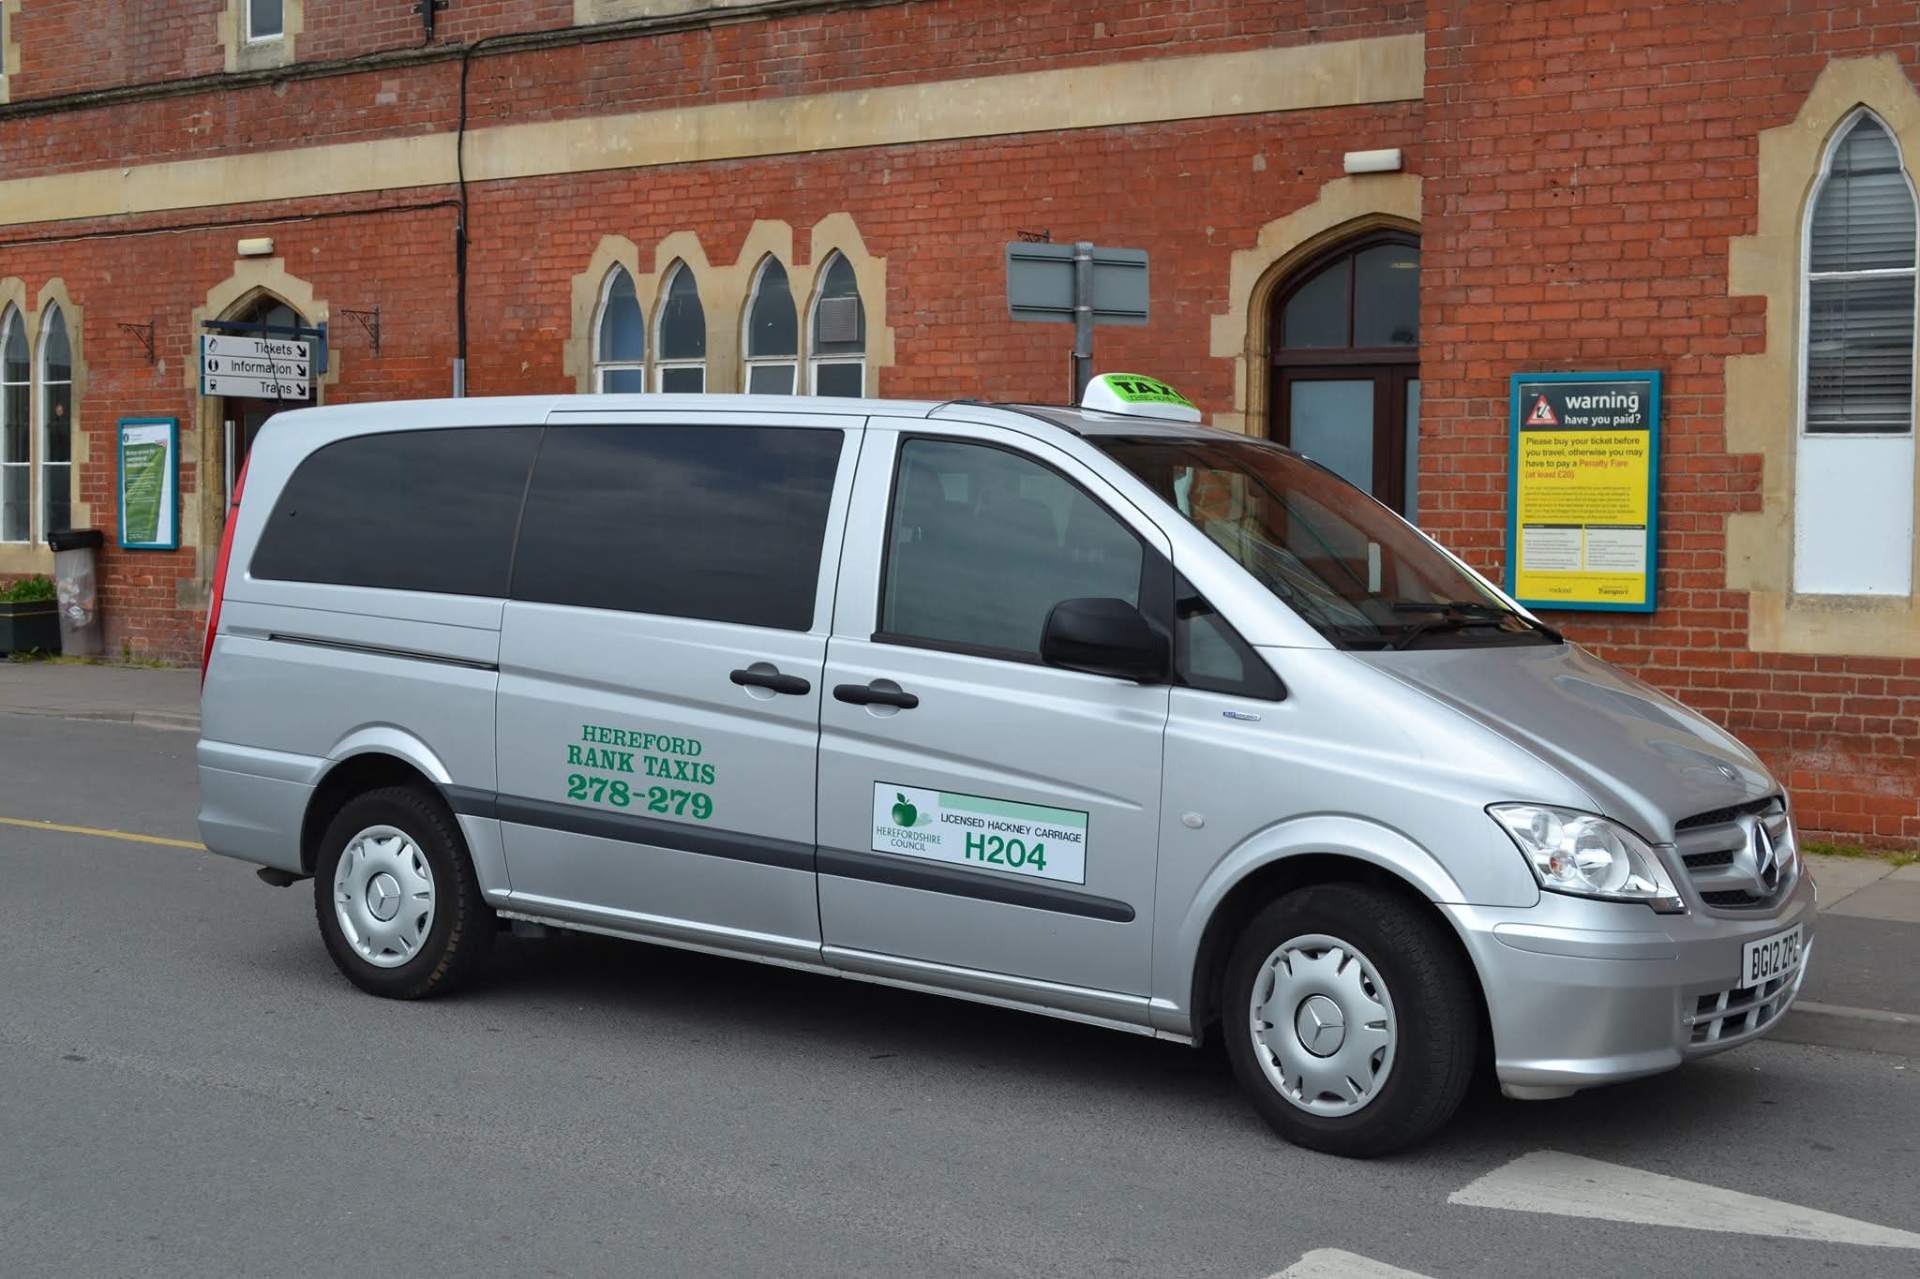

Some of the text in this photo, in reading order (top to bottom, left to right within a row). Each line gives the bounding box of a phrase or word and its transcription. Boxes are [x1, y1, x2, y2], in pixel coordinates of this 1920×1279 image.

[254, 342, 293, 355] Tickets
[231, 360, 292, 375] Information
[1113, 381, 1186, 401] TAXI
[1565, 391, 1639, 413] warning
[1564, 415, 1589, 424] have
[1591, 417, 1611, 426] you
[1613, 413, 1641, 427] paid?
[1526, 436, 1640, 446] Please buy your ticket before
[1568, 448, 1606, 457] otherwise
[1609, 449, 1624, 457] you
[1626, 449, 1643, 457] may
[1525, 460, 1545, 468] have
[1556, 461, 1570, 469] pay
[1579, 459, 1608, 468] Penalty
[1611, 459, 1629, 467] Fare
[1525, 471, 1536, 479] (at
[582, 724, 702, 757] HEREFORD
[567, 744, 716, 785] RANK TAXIS
[567, 773, 713, 820] 278-279
[876, 825, 942, 845] HEREFORDSHIRE
[940, 812, 1082, 844] LICENSED HACKNEY CARRIAGE
[890, 838, 926, 852] COUNCIL
[965, 831, 1047, 872] H204
[1751, 941, 1780, 981] BG12
